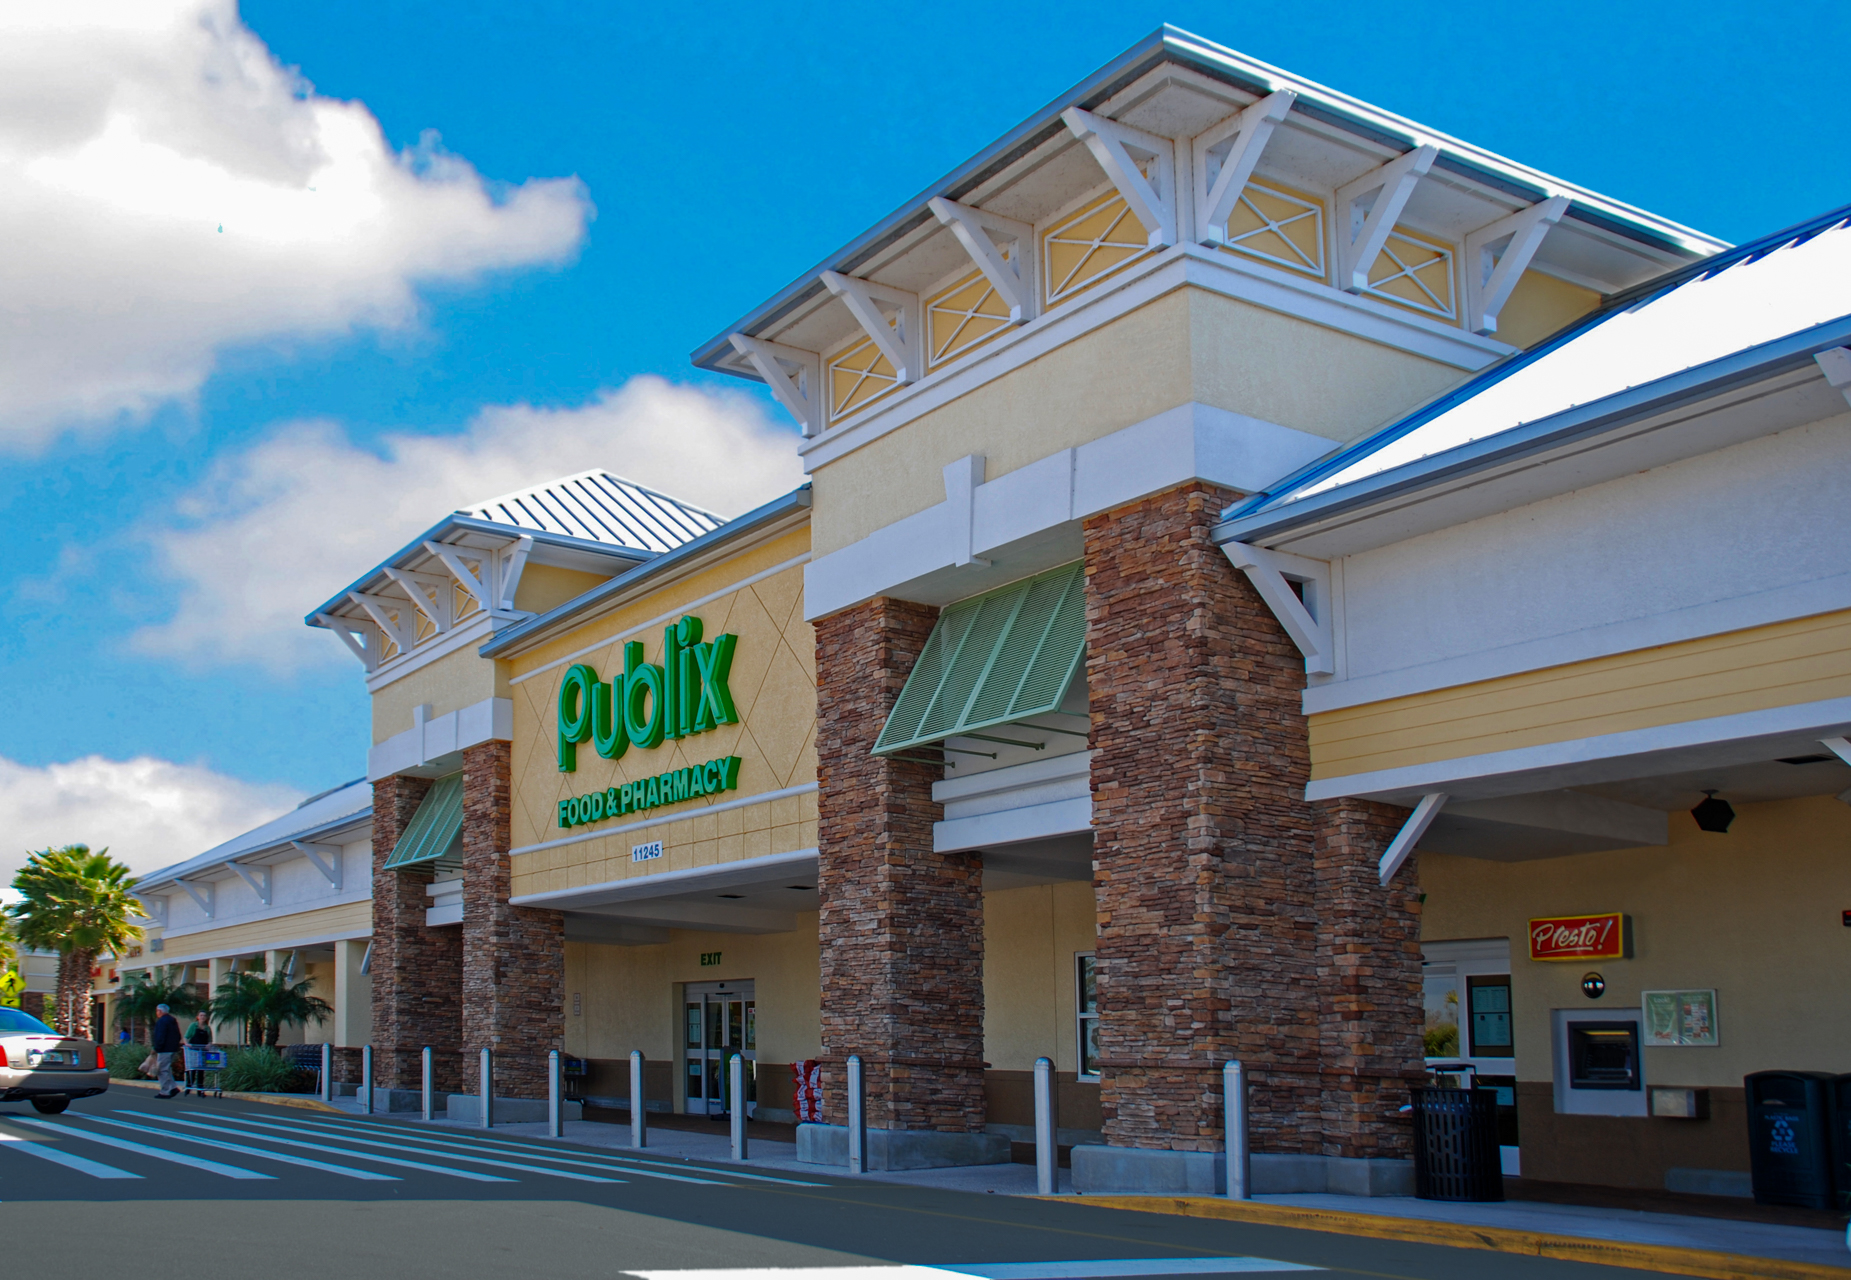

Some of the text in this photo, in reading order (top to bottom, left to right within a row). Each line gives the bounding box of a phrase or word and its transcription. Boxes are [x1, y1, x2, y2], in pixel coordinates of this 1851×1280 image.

[558, 615, 739, 773] Publix
[558, 755, 742, 828] FOOD & PHARMACY
[633, 844, 660, 861] 11245
[1532, 919, 1614, 952] Presto!
[700, 952, 722, 966] EXIT
